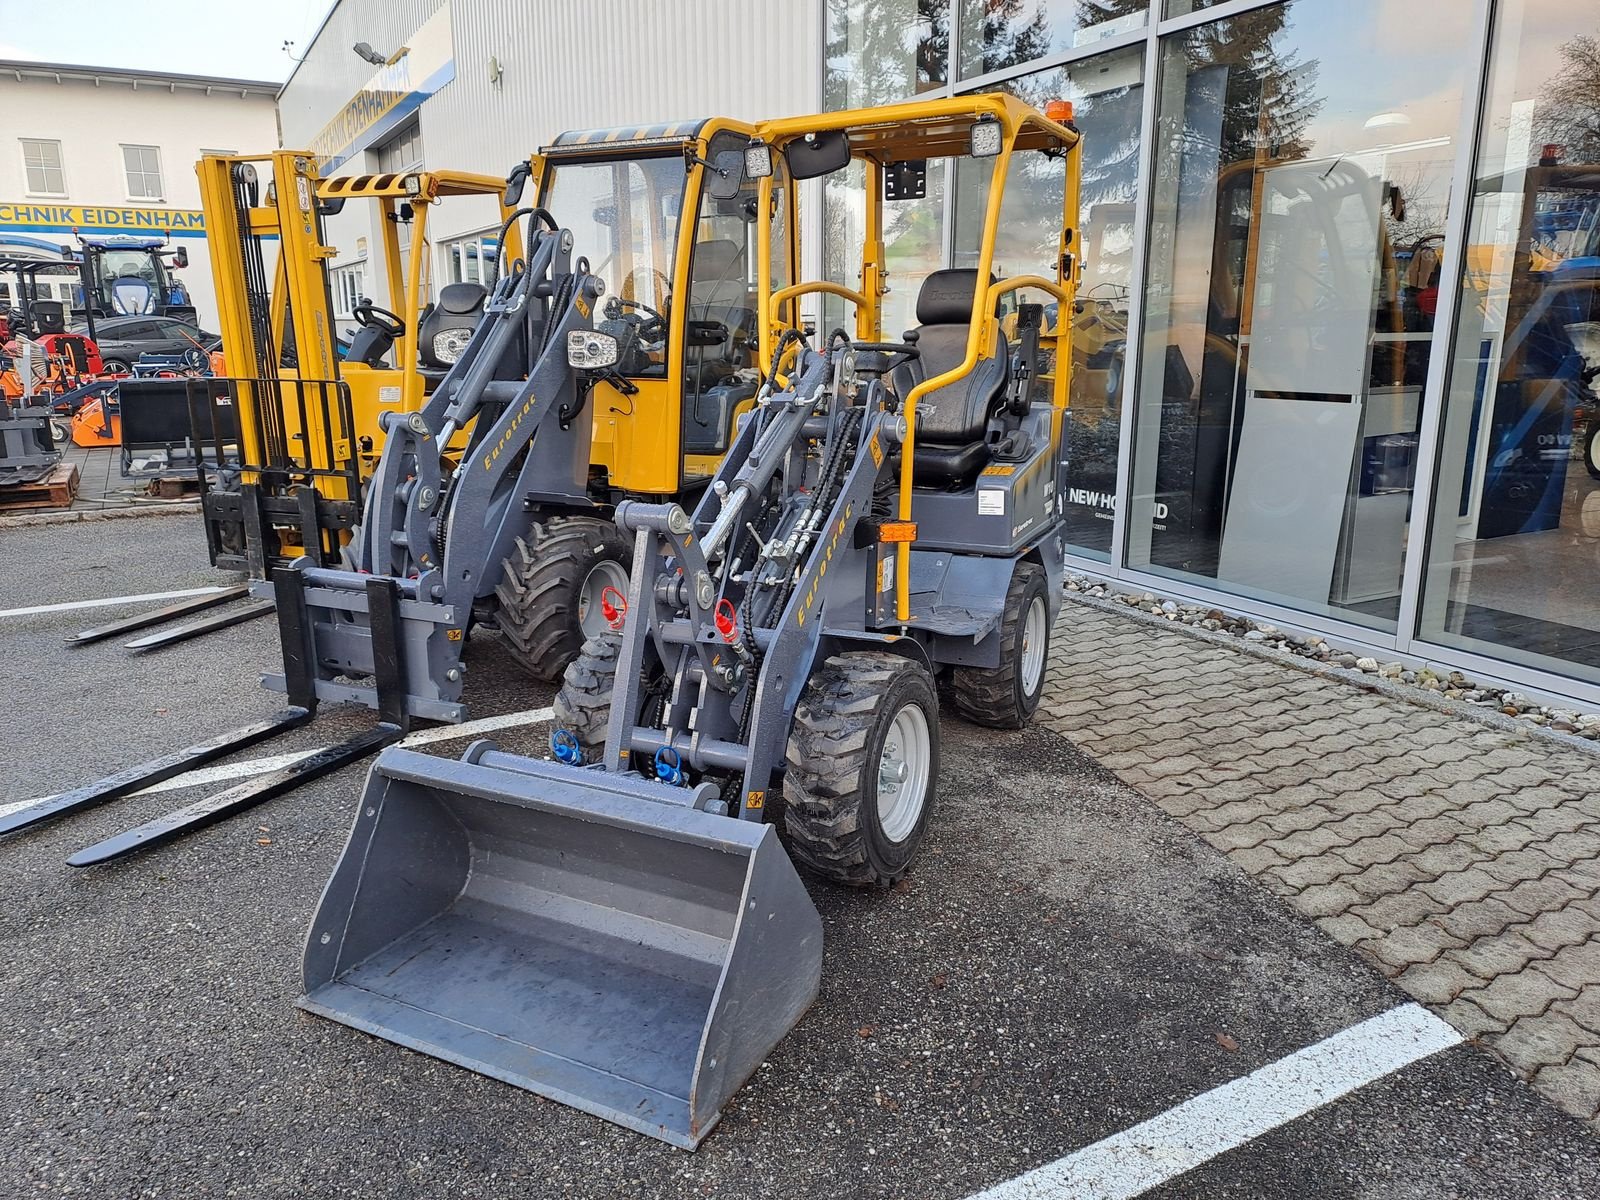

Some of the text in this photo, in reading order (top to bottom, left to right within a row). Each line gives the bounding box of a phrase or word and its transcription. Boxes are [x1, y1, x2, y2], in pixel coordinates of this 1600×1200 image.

[82, 209, 205, 228] EIDENHAM
[484, 393, 536, 471] Eurotrac
[1069, 487, 1099, 507] NEW
[797, 503, 852, 628] Eurotrac
